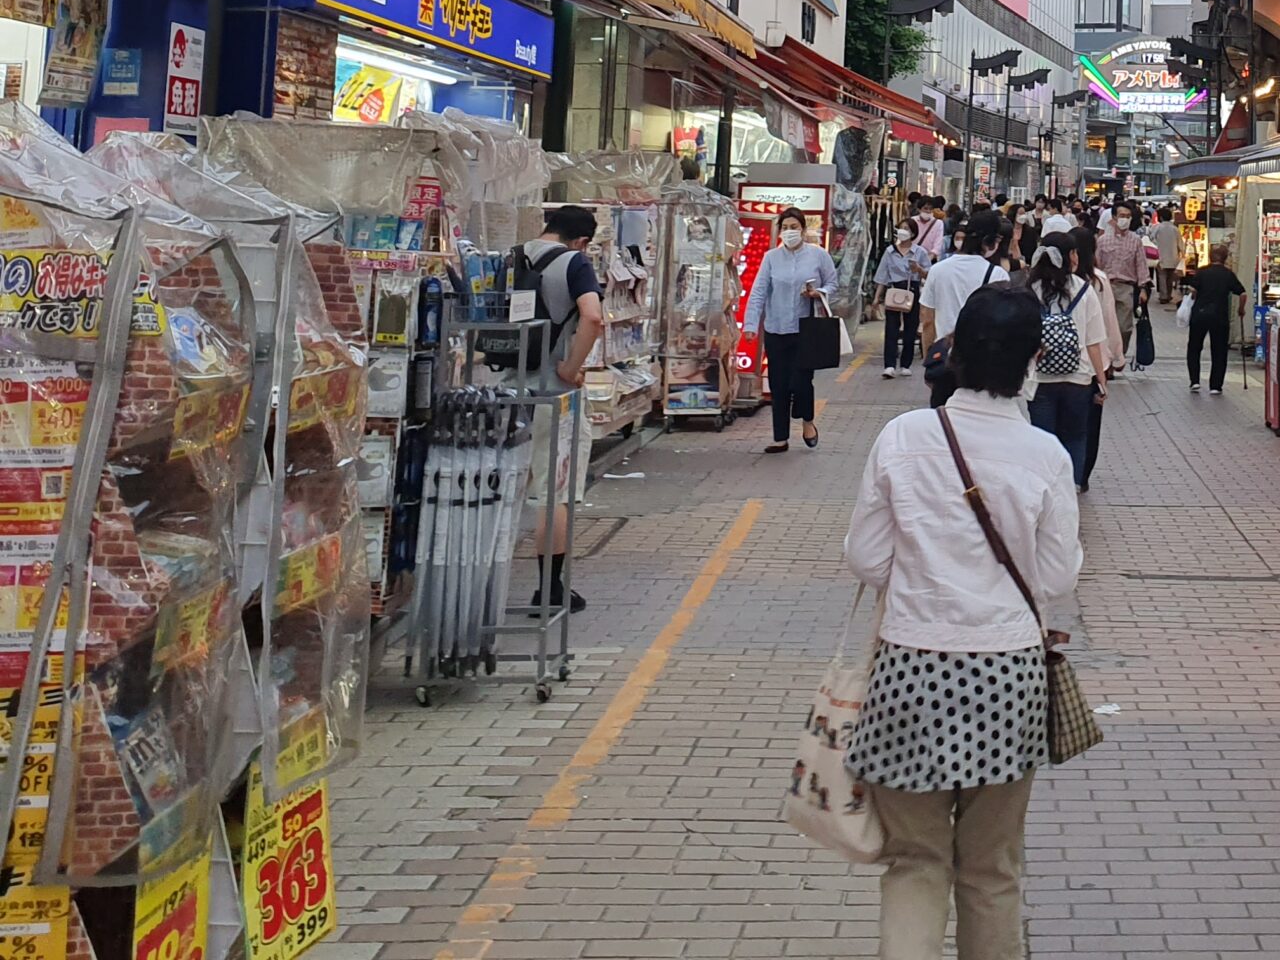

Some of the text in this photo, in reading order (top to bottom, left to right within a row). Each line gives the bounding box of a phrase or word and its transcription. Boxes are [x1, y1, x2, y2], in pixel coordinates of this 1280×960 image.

[170, 80, 197, 116] 免税
[257, 826, 328, 945] 363
[297, 906, 328, 945] 399
